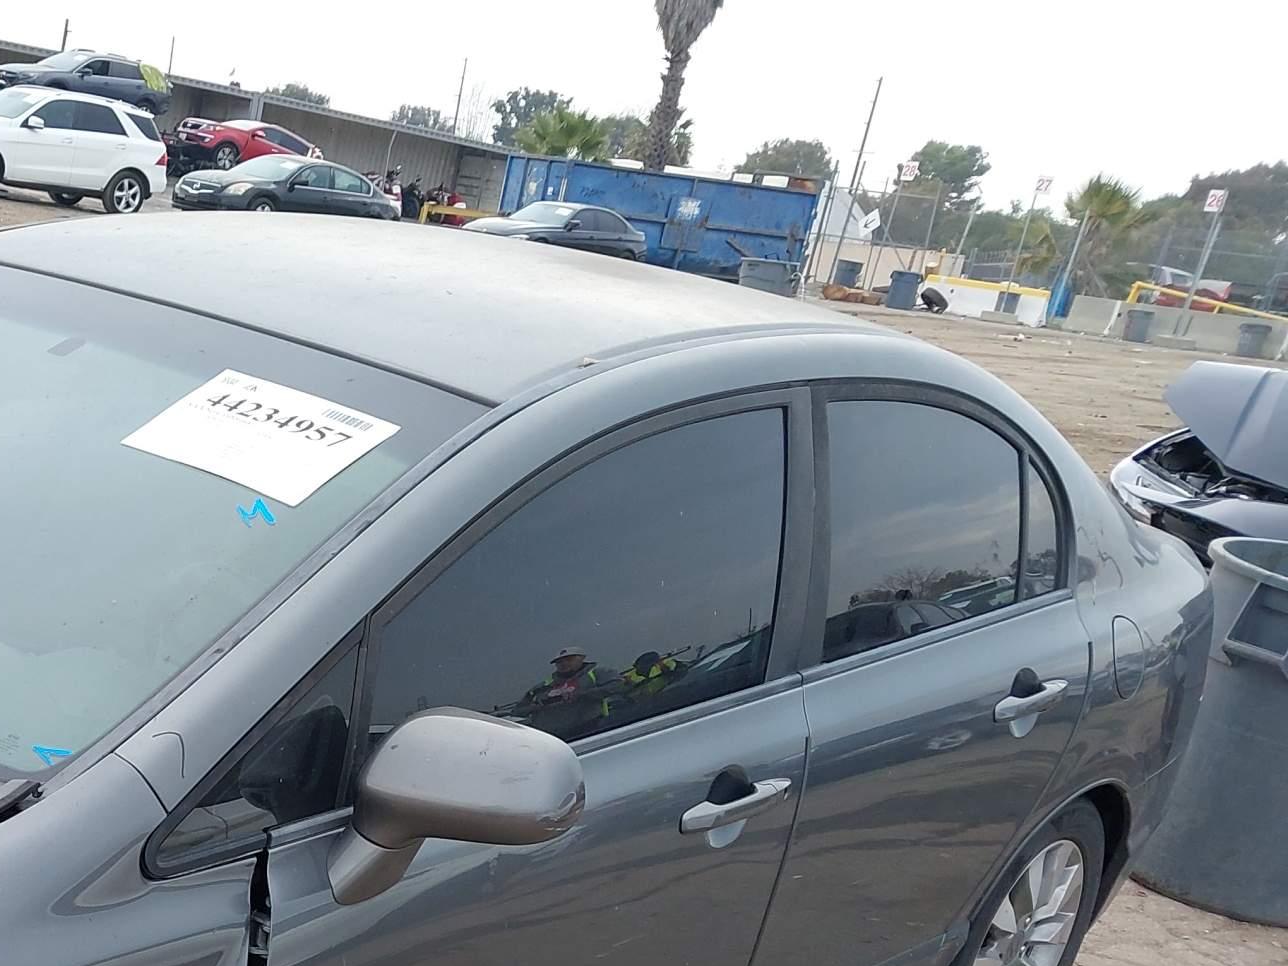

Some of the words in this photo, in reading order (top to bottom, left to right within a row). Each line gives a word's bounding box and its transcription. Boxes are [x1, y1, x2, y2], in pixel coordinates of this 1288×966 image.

[902, 164, 917, 177] 28
[1035, 177, 1054, 192] 27
[207, 394, 353, 447] 44234957
